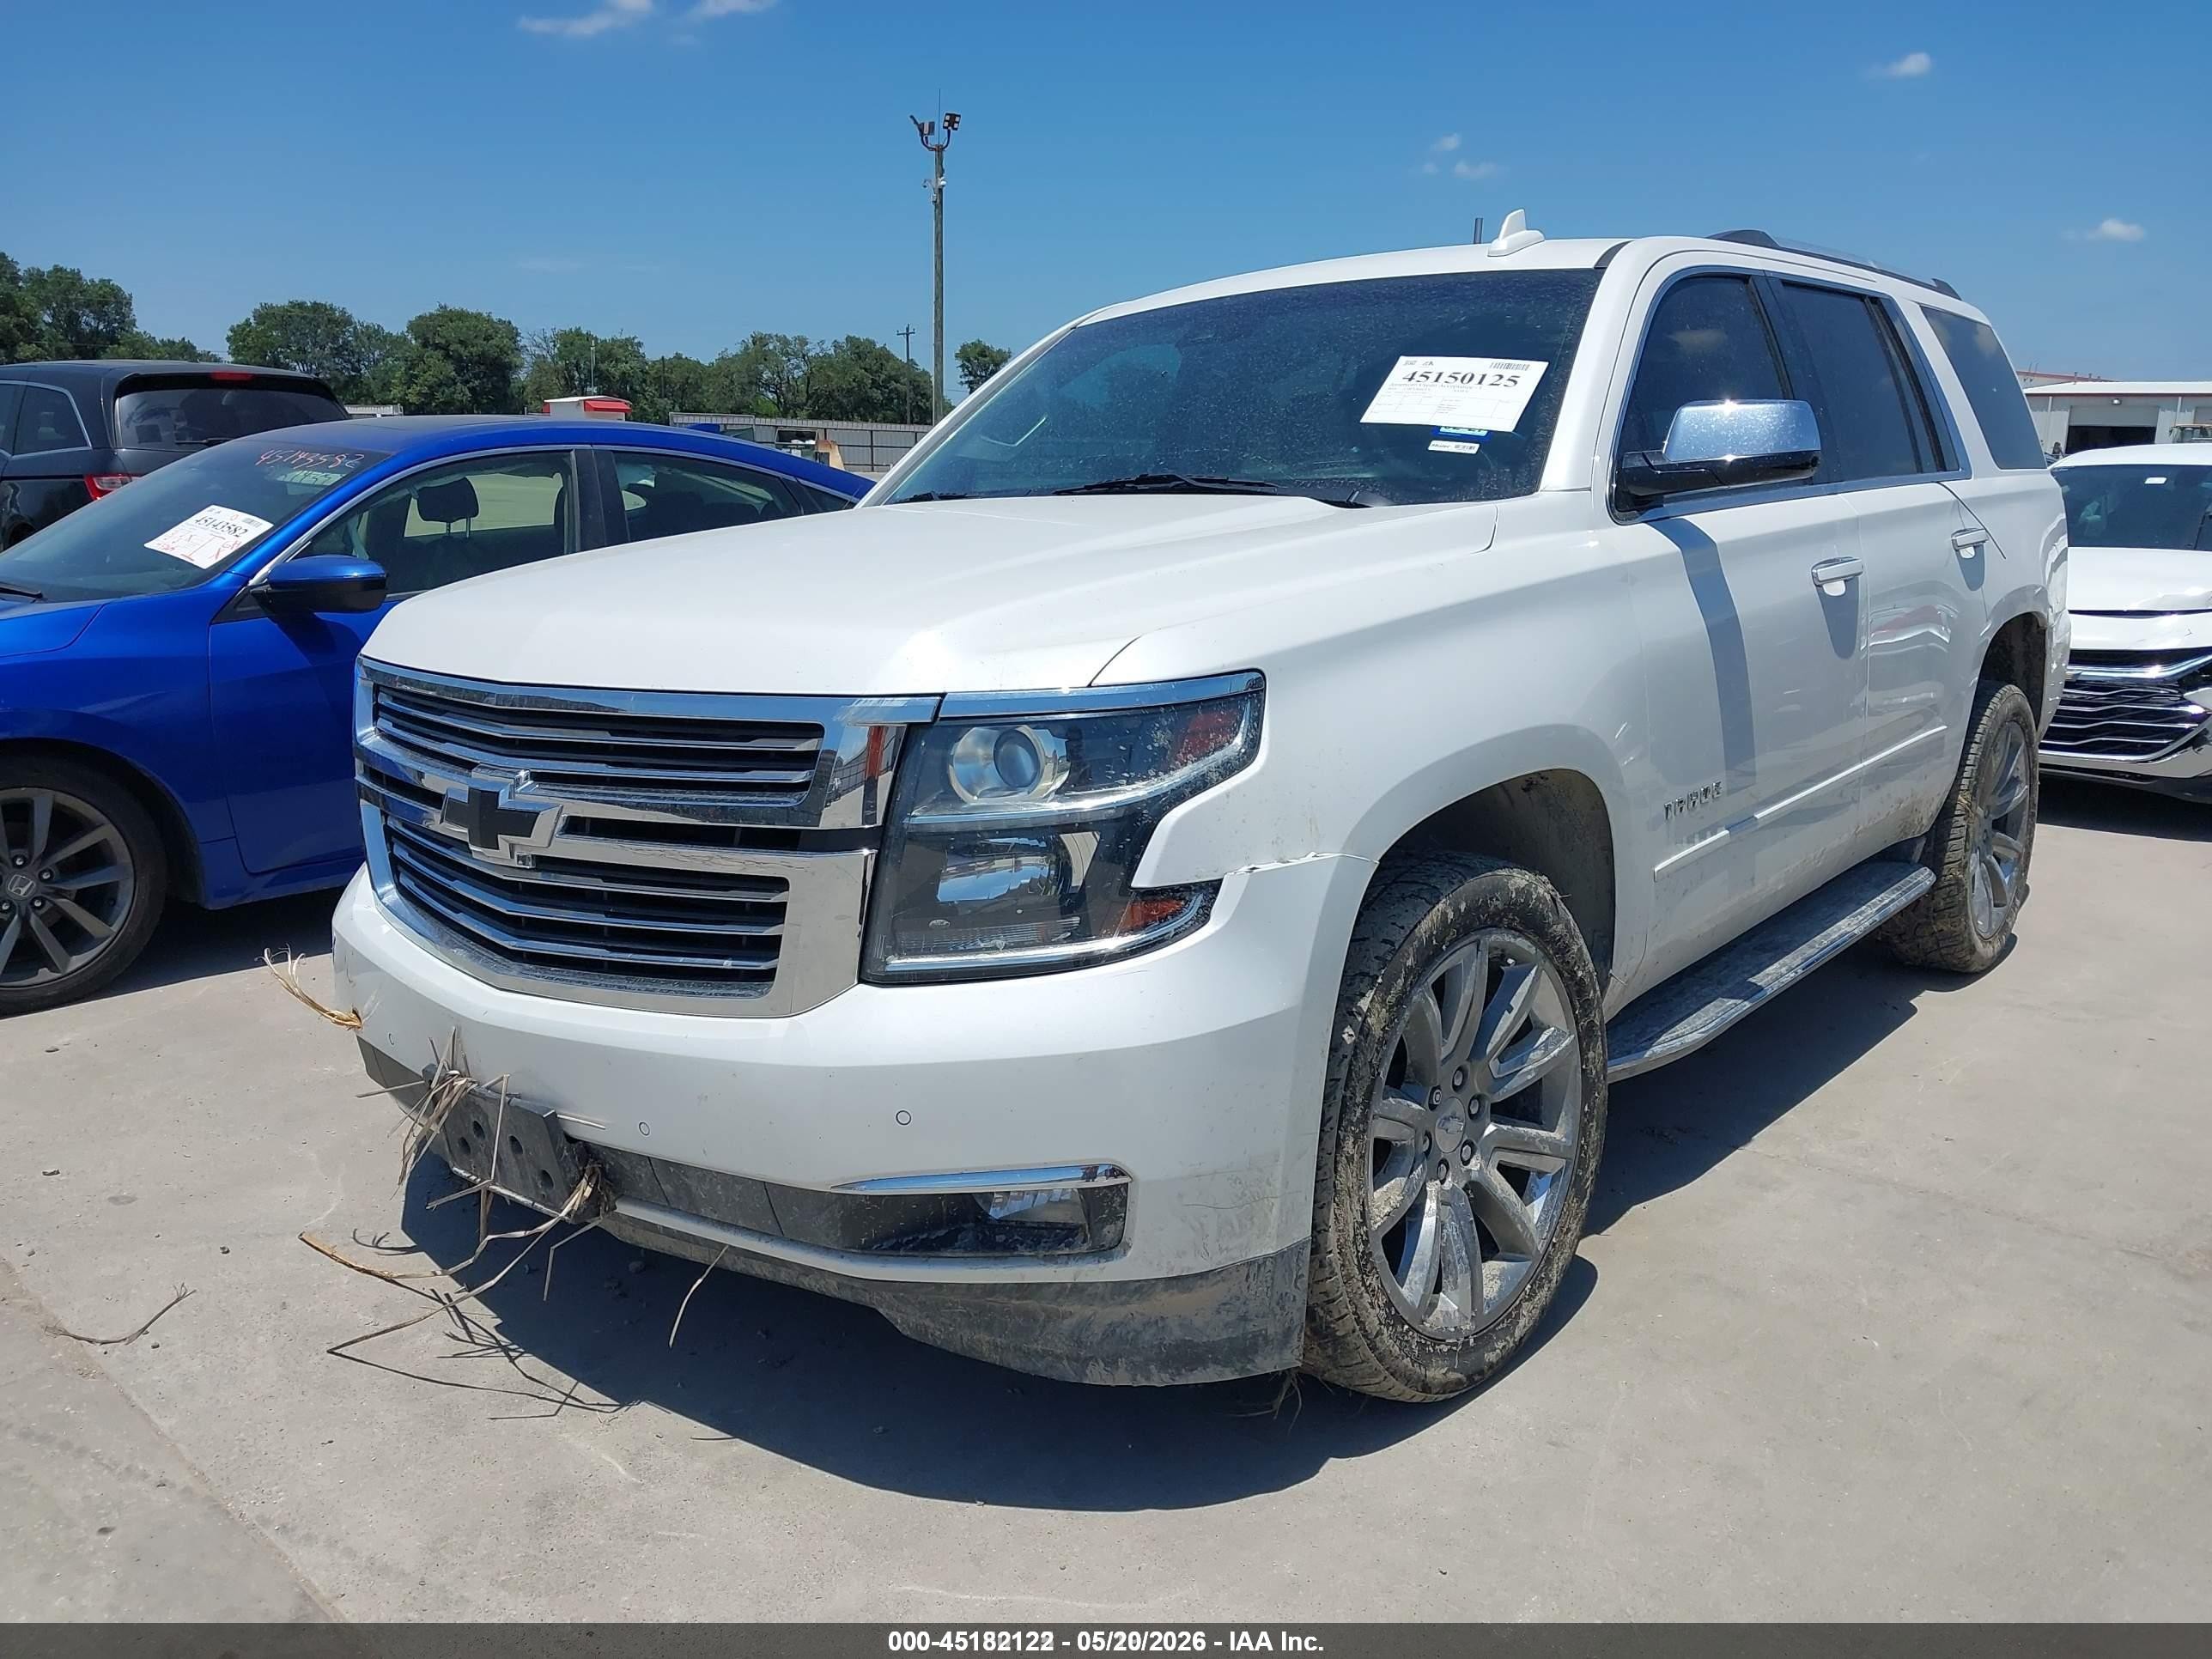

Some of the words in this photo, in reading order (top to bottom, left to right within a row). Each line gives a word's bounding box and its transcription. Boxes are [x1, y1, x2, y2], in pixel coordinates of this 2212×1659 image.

[1402, 370, 1522, 387] 45150125
[255, 448, 365, 470] 45143582
[194, 515, 248, 538] 45143582
